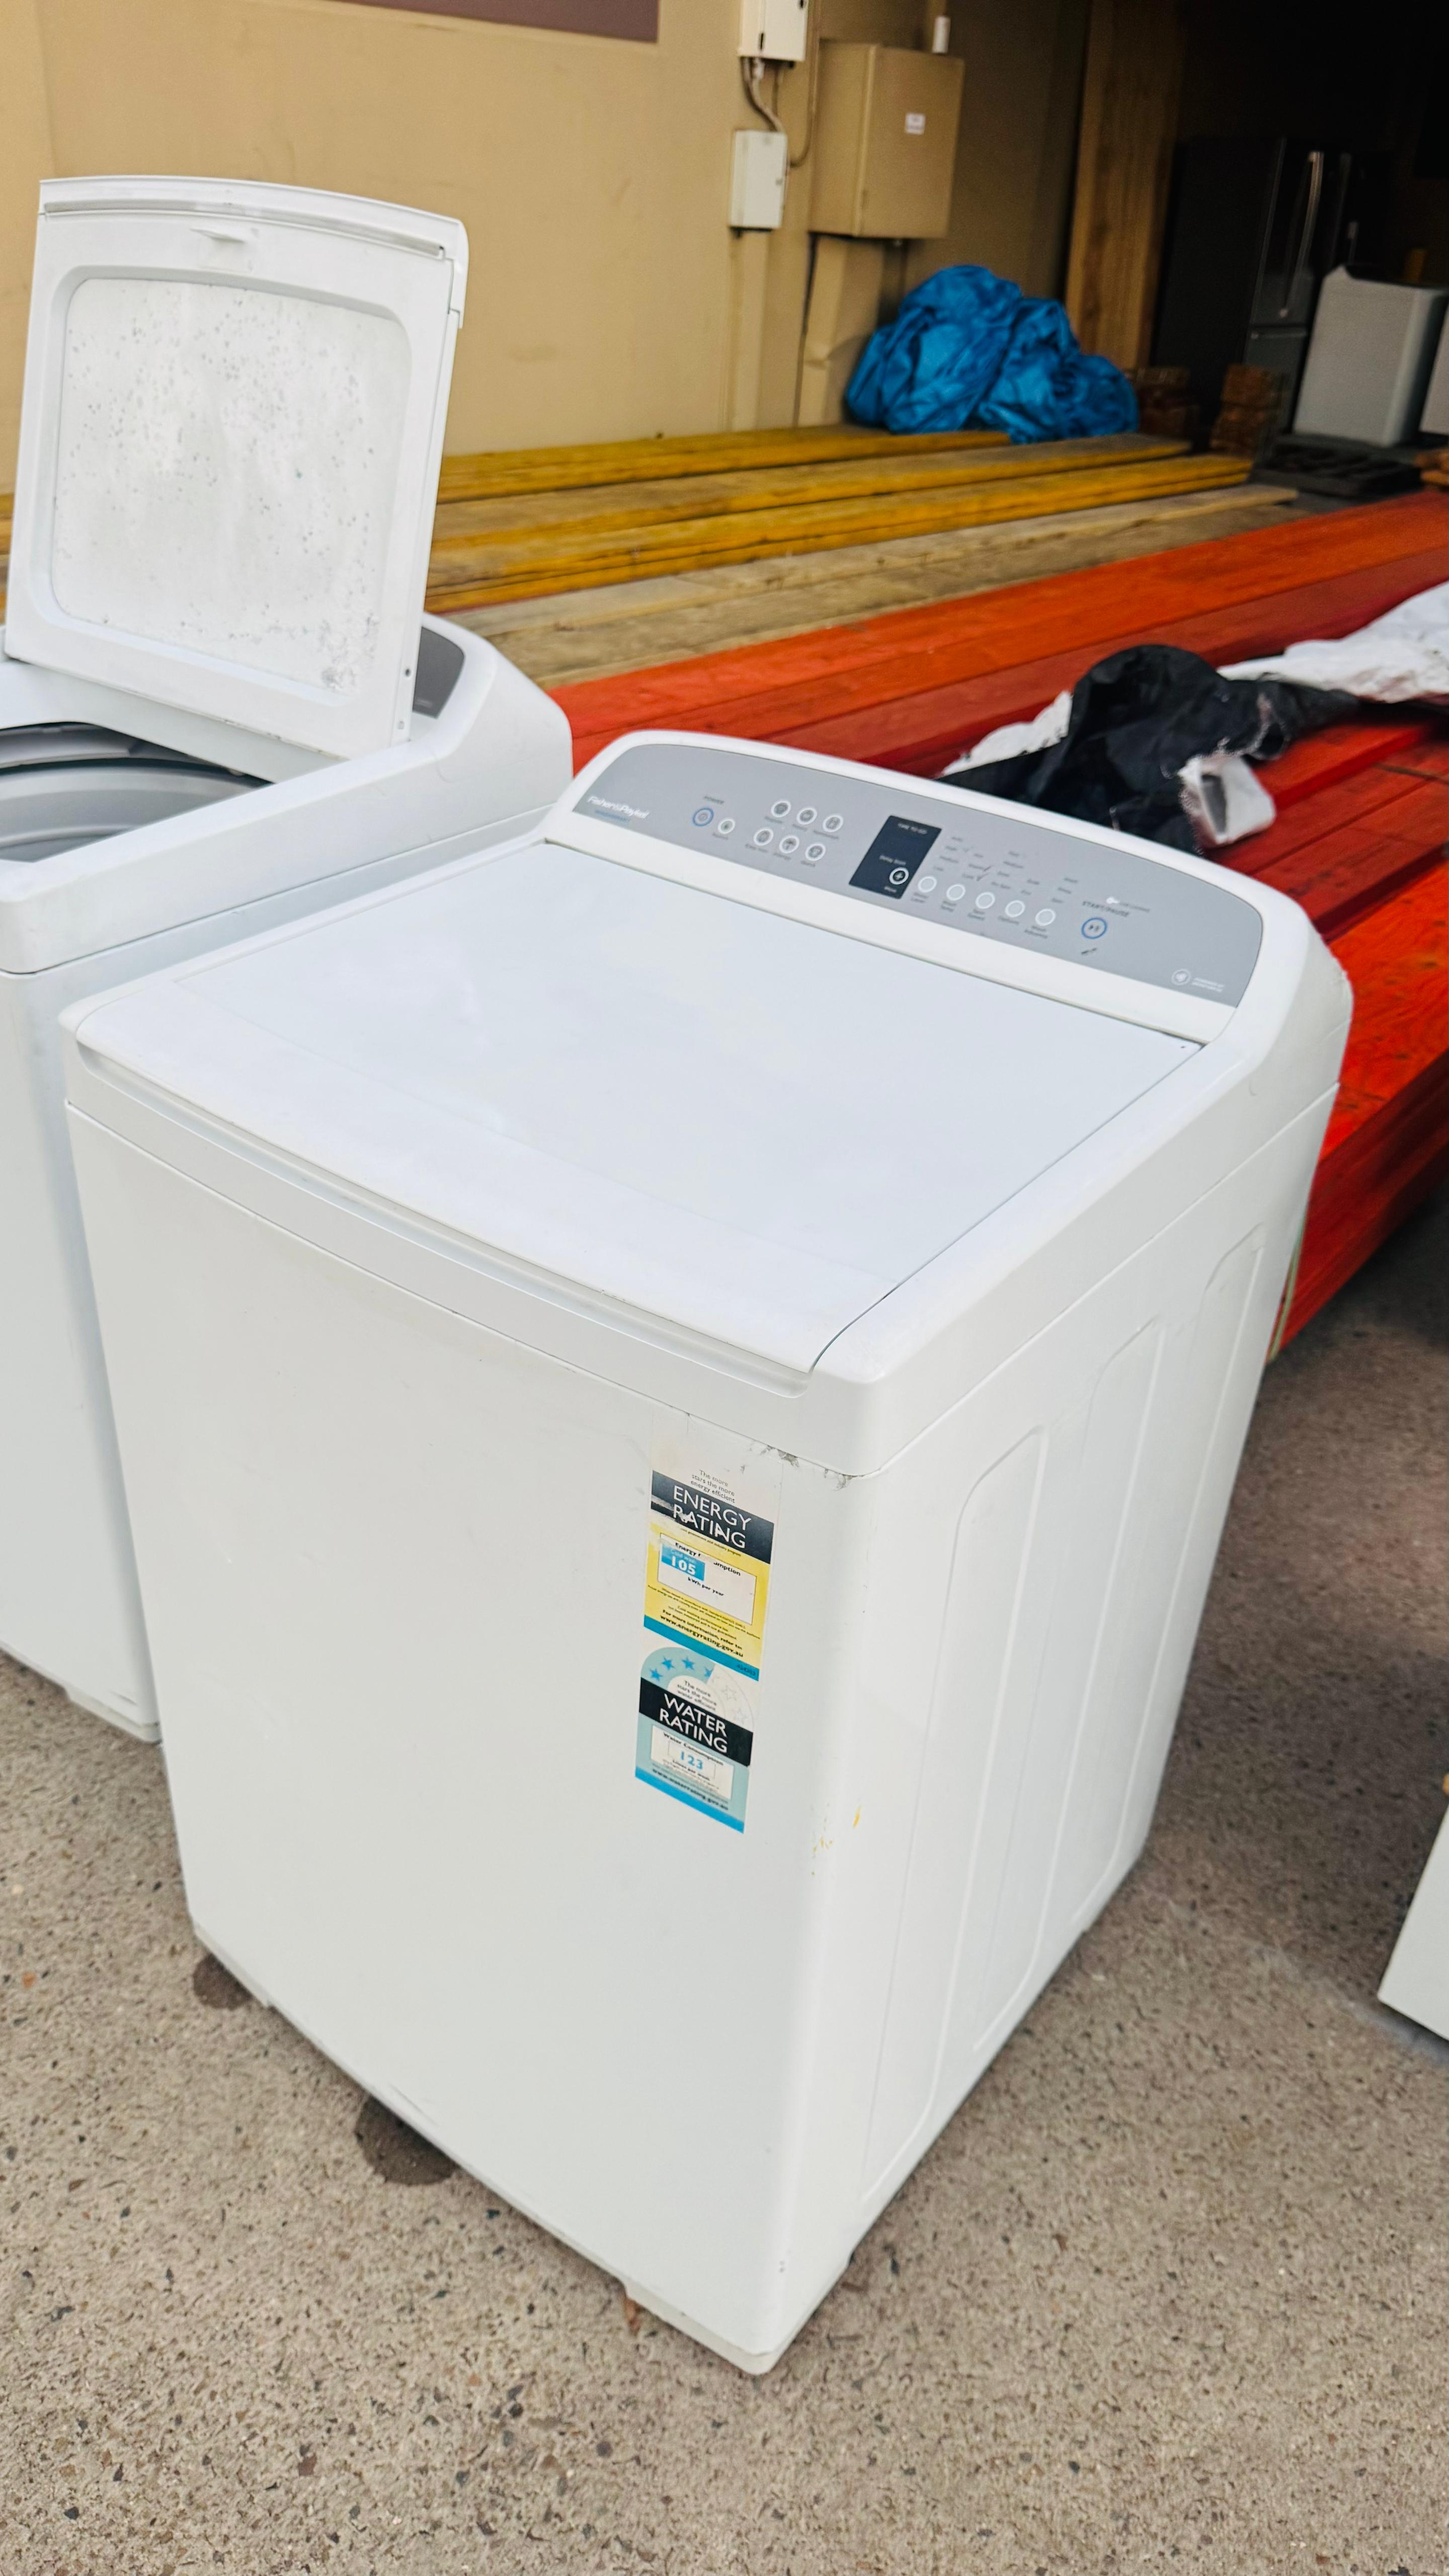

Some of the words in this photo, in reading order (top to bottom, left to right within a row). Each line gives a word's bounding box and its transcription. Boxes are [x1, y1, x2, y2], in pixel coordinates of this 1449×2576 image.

[692, 1474, 706, 1485] stars
[707, 1479, 717, 1489] the
[718, 1486, 735, 1497] more
[700, 1470, 710, 1479] The
[712, 1477, 729, 1487] more
[691, 1480, 710, 1493] energy
[712, 1489, 735, 1503] efficient
[673, 1484, 751, 1533] ENERGY
[673, 1503, 746, 1548] RATING
[675, 1542, 696, 1557] Energy
[671, 1554, 696, 1576] 105
[687, 1576, 700, 1586] kWh
[660, 1614, 743, 1657] www.energyrating.gov.au
[672, 1614, 686, 1624] more
[720, 1636, 734, 1646] refer
[684, 1680, 695, 1689] The
[663, 1693, 728, 1738] WATER
[659, 1707, 728, 1753] RATING
[663, 1731, 682, 1745] Water
[683, 1741, 724, 1767] Consumption
[680, 1749, 704, 1771] 123
